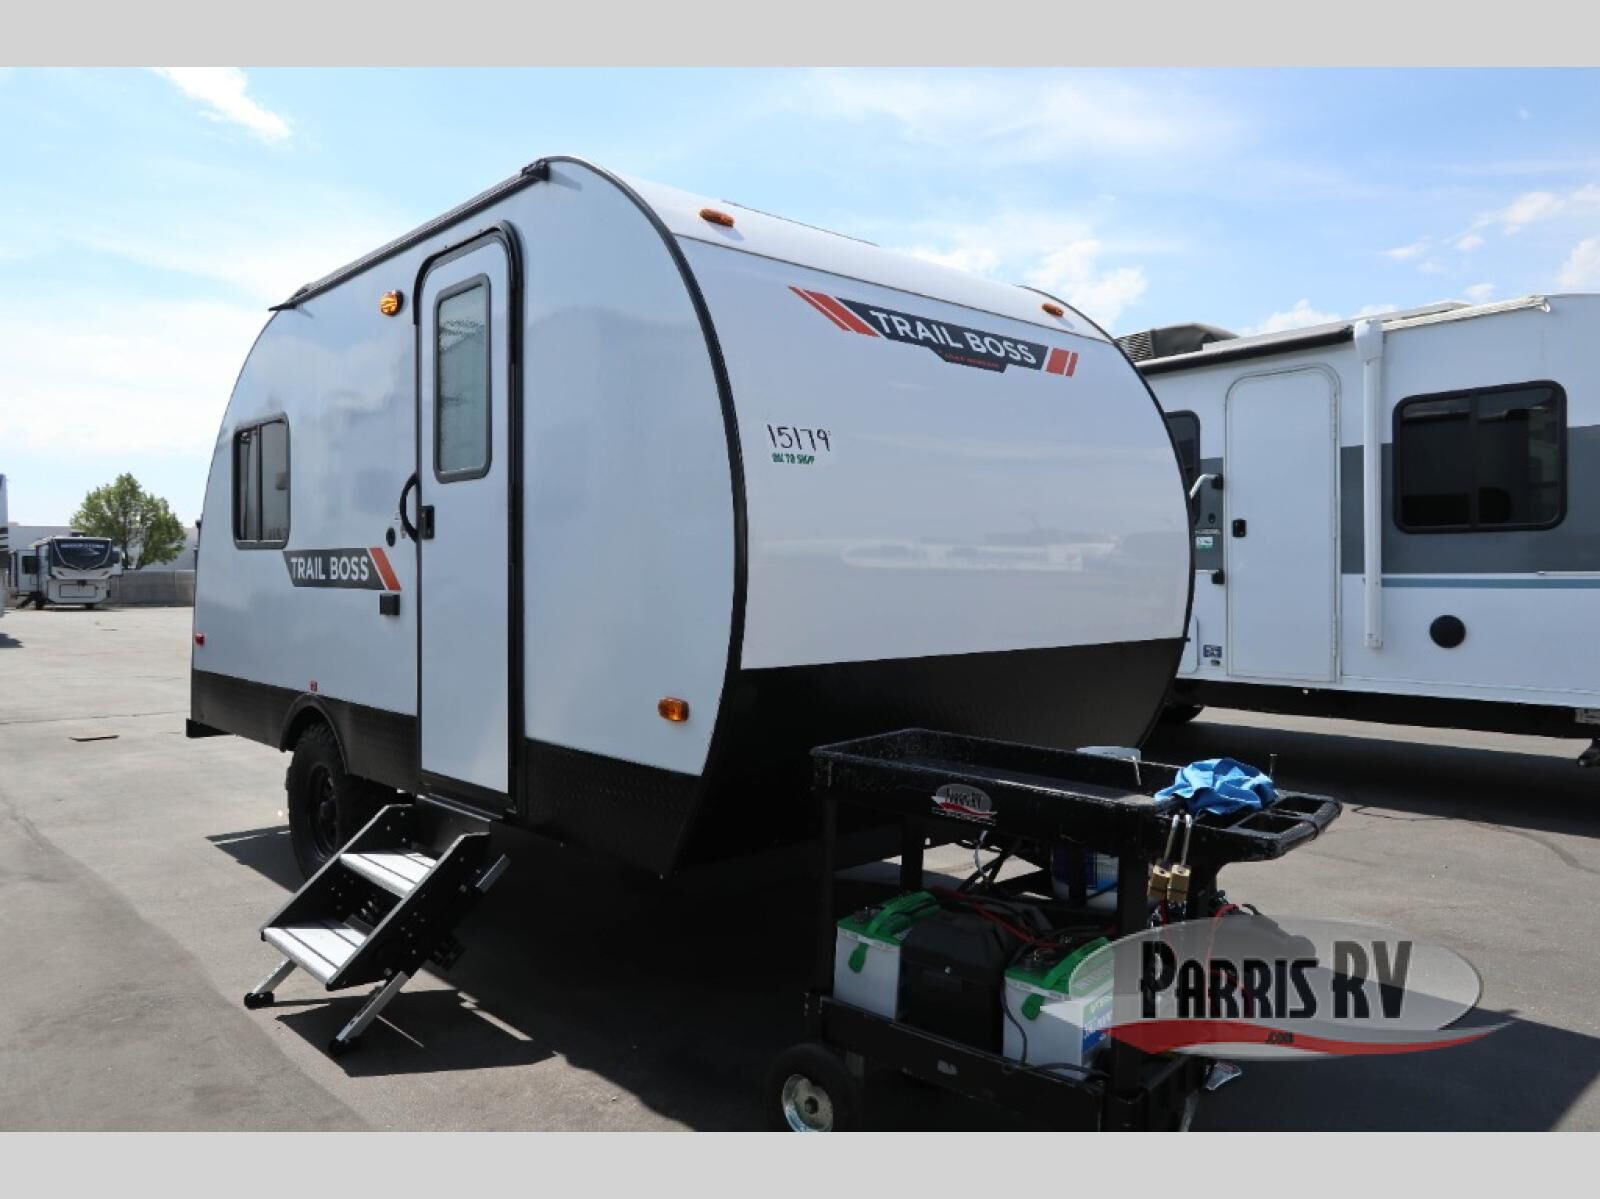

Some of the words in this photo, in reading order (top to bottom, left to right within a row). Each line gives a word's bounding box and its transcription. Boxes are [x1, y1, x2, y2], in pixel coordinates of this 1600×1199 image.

[869, 310, 964, 349] TRAIL
[964, 331, 1037, 365] BOSS
[767, 424, 830, 452] 15179
[290, 557, 326, 580] TRAIL
[329, 556, 369, 581] BOSS
